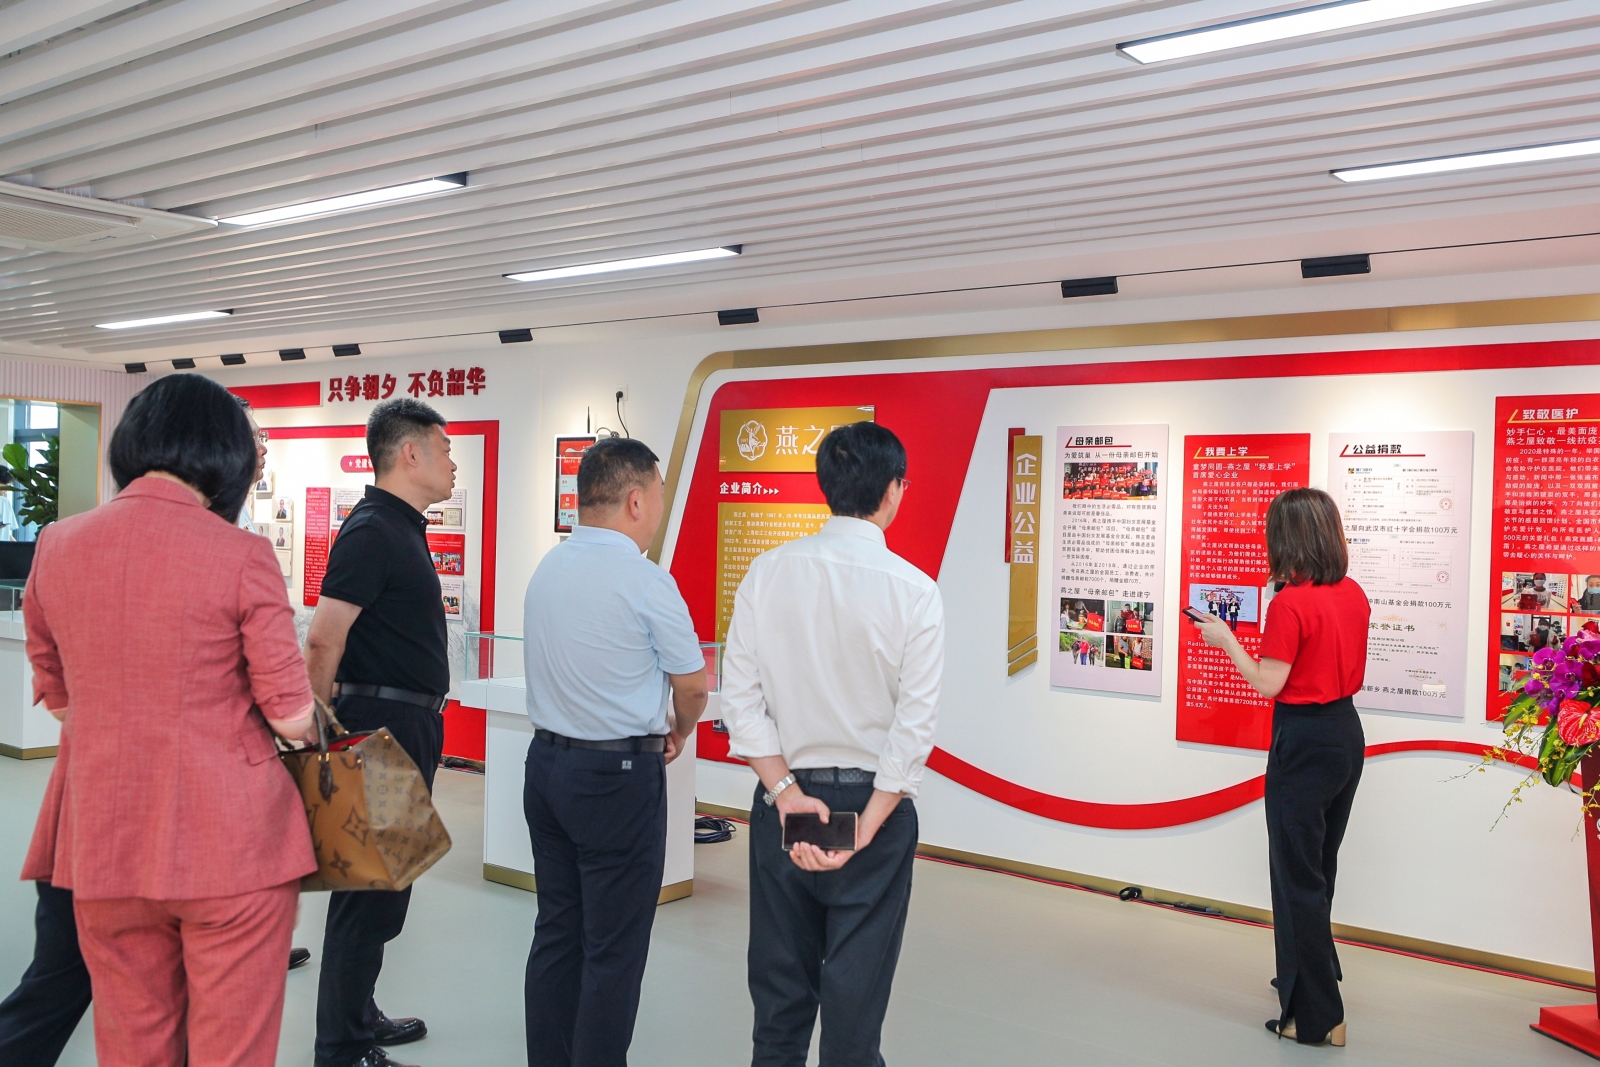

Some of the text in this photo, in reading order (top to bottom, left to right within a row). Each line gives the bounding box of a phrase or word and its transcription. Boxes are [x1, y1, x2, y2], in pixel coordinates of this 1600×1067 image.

[327, 366, 486, 402] 只争朝夕 不负韶华
[1522, 408, 1579, 420] 致敬医护
[775, 425, 852, 455] 燕之
[1075, 436, 1114, 445] 母亲邮包
[1205, 447, 1248, 457] 我要上学
[1352, 444, 1402, 455] 公益捐款
[1192, 471, 1239, 479] 首席爱心企业
[719, 481, 763, 495] 企业简介
[1505, 482, 1600, 490] 勒痕的脸庞，以及一双双因戴
[1013, 452, 1037, 564] 企业公益
[1190, 557, 1269, 566] 补助，用实际行动帮助他们解决
[1369, 622, 1416, 632] 荣誉证书
[1187, 656, 1234, 665] 爱心义演和义卖特
